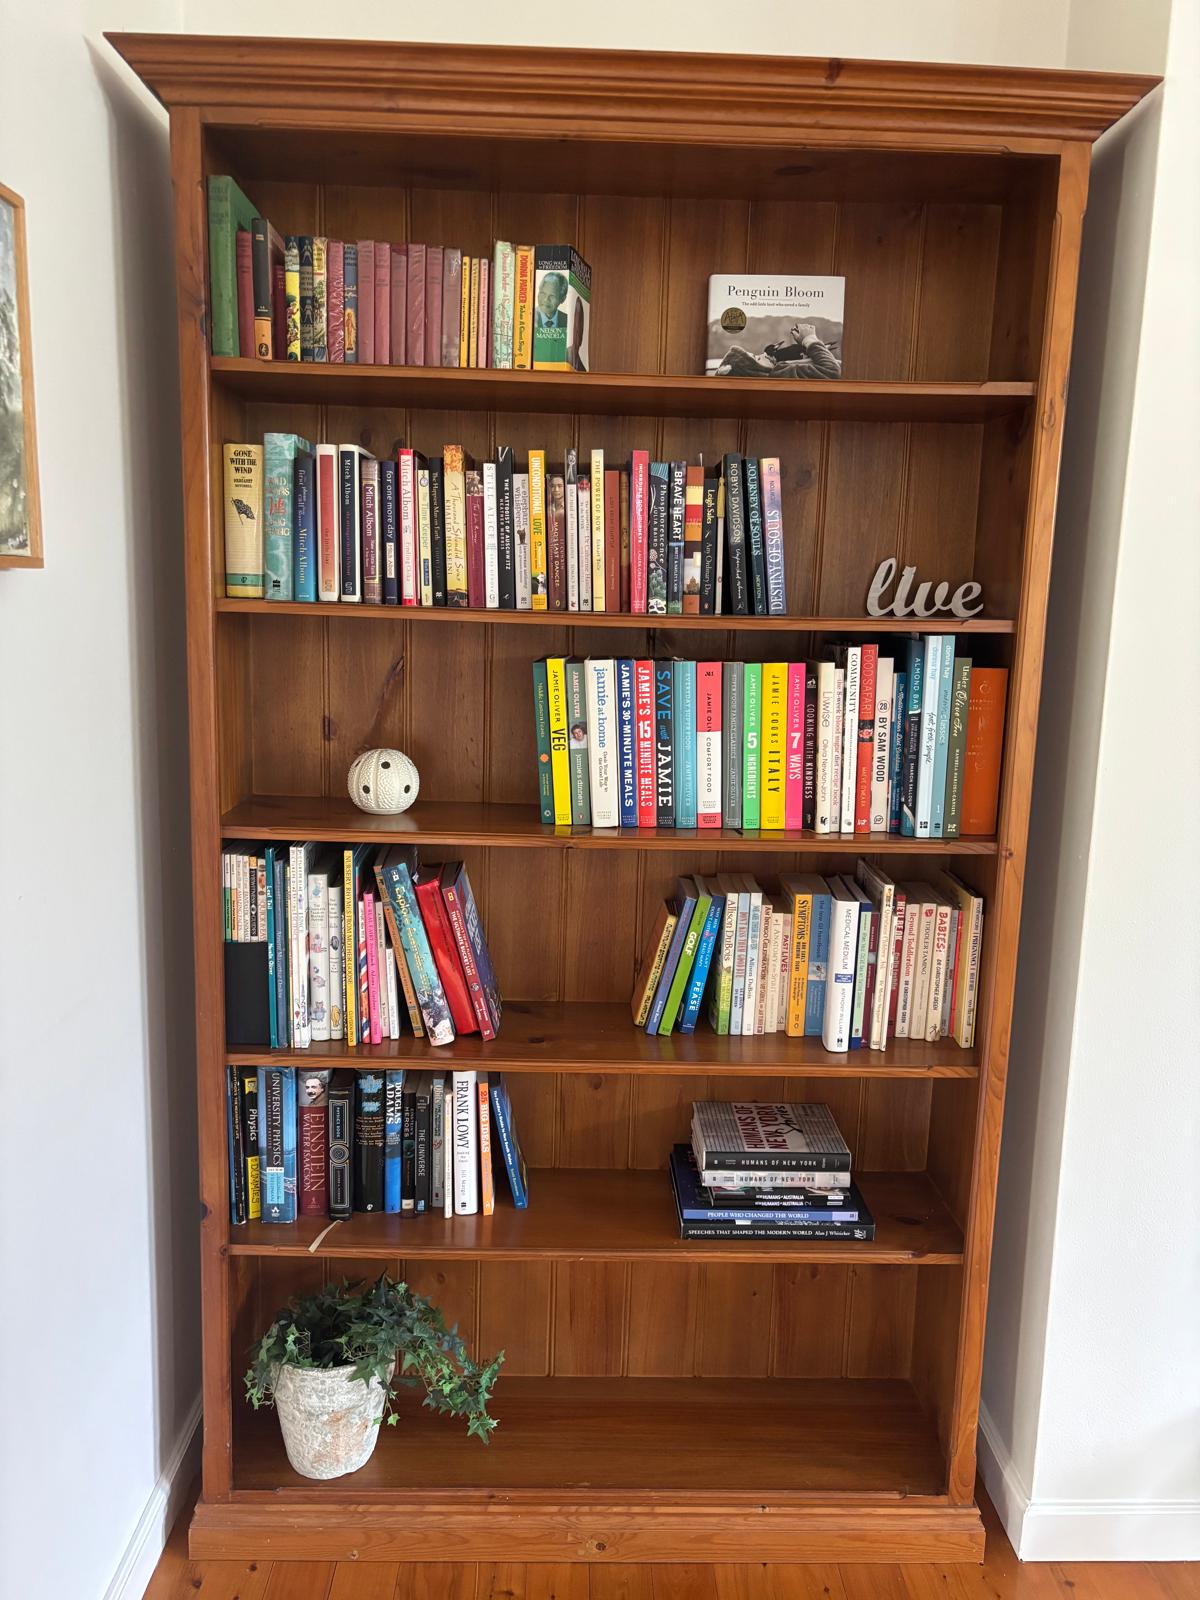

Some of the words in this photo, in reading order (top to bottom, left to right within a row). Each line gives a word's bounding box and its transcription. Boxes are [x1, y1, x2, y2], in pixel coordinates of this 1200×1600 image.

[519, 279, 527, 303] PARKER
[728, 285, 779, 300] Penguin
[785, 286, 824, 298] Bloom
[402, 458, 410, 486] Mitch
[531, 457, 541, 515] UNCONDITIONAL
[674, 471, 682, 504] BRAVE
[747, 463, 758, 508] JOURNEY
[402, 489, 412, 520] Albom
[514, 486, 522, 529] whisperer
[706, 490, 715, 507] Leigh
[505, 525, 510, 533] OF
[533, 518, 542, 535] LOVE
[659, 485, 667, 563] Phosphorescence
[673, 507, 682, 540] HEART
[706, 508, 714, 524] Sales
[732, 497, 741, 543] DAVIDSON
[751, 511, 759, 524] OF
[767, 510, 780, 545] SOULS
[299, 528, 307, 553] Mitch
[751, 527, 761, 556] SOULS
[768, 547, 779, 563] OF
[769, 565, 784, 610] DESTINY
[593, 667, 608, 706] jamie
[621, 664, 631, 708] JAMIE'S
[637, 667, 651, 715] JAMIE'S
[657, 671, 670, 720] SAVE
[771, 675, 779, 704] JAMIE
[849, 653, 858, 714] COMMUNITY
[553, 695, 561, 723] OLIVER
[597, 707, 604, 716] at
[806, 704, 814, 737] COOKING
[879, 702, 888, 711] 28
[598, 717, 607, 748] home
[622, 711, 632, 767] 30-MINUTE
[639, 720, 651, 739] 15
[771, 712, 779, 744] COOKS
[878, 717, 887, 730] BY
[552, 729, 566, 751] VEG
[748, 733, 757, 749] 5
[790, 733, 800, 749] 7
[877, 732, 887, 752] SAM
[639, 741, 651, 775] MINUTE
[768, 751, 780, 793] ITALY
[789, 754, 801, 780] WAYS
[876, 756, 885, 782] WOOD
[624, 770, 633, 806] MEALS
[658, 742, 671, 807] JAMIE
[747, 754, 756, 799] INGREDIENTS
[805, 763, 814, 799] KINDNESS
[640, 778, 652, 807] MEALS
[394, 887, 410, 926] Explore
[407, 927, 425, 971] Australia
[726, 899, 736, 928] Allison
[797, 900, 808, 940] SYMPTOMS
[452, 922, 464, 945] ULTIMATE
[460, 945, 469, 965] BUCKET
[685, 931, 697, 956] GOLF
[723, 930, 736, 961] DuBois
[922, 920, 930, 951] TODDLER
[781, 951, 789, 973] LIVES
[688, 981, 701, 1012] PEASE
[272, 1072, 281, 1128] UNIVERSITY
[386, 1082, 394, 1124] ADAMS
[457, 1080, 469, 1115] FRANK
[480, 1090, 488, 1103] 25
[248, 1108, 258, 1141] Physics
[457, 1118, 469, 1148] LOWY
[481, 1123, 489, 1152] IDEAS
[273, 1129, 281, 1166] PHYSICS
[310, 1113, 325, 1191] EINSTEIN
[418, 1144, 426, 1176] UNIVERSE
[251, 1163, 260, 1204] DUMMIES
